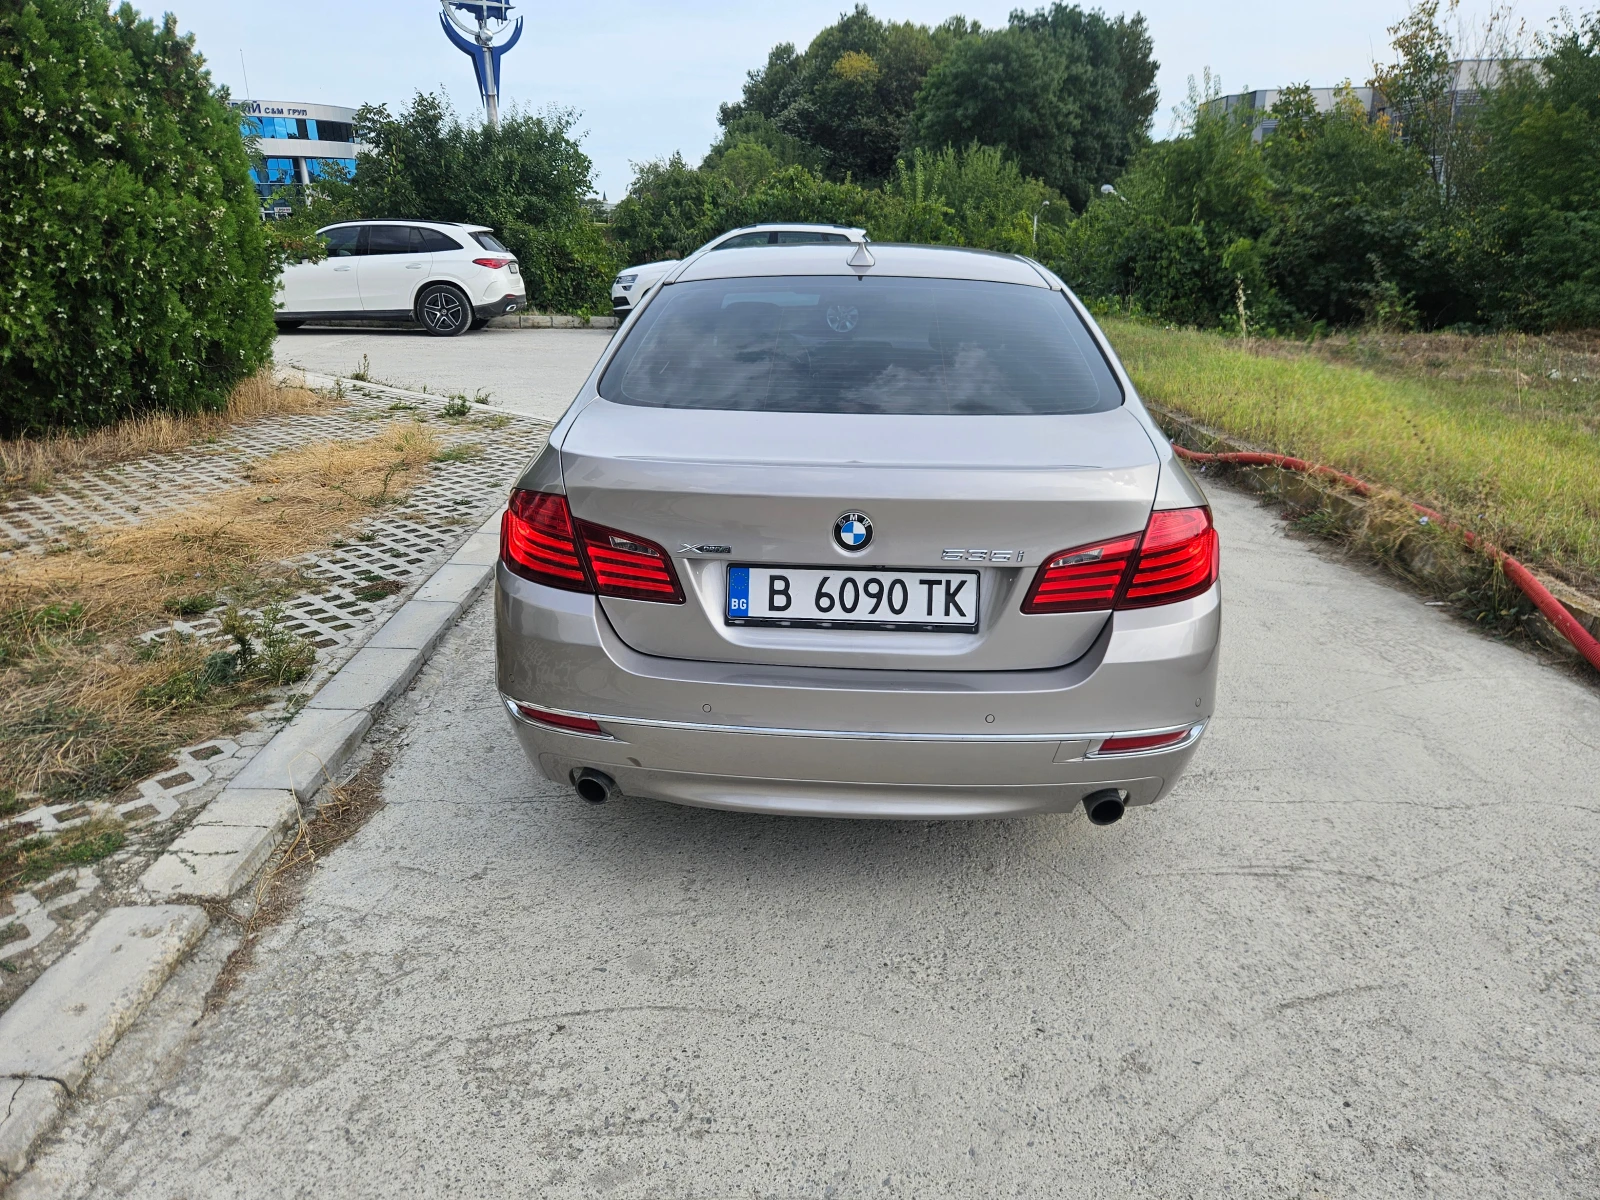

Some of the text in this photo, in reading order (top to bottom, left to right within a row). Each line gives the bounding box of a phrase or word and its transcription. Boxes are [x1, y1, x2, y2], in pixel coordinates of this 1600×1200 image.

[287, 108, 308, 117] ГРУП
[837, 513, 871, 528] BMW
[941, 548, 1025, 563] 535i
[767, 574, 968, 618] B 6090 TK
[731, 598, 747, 610] BG
